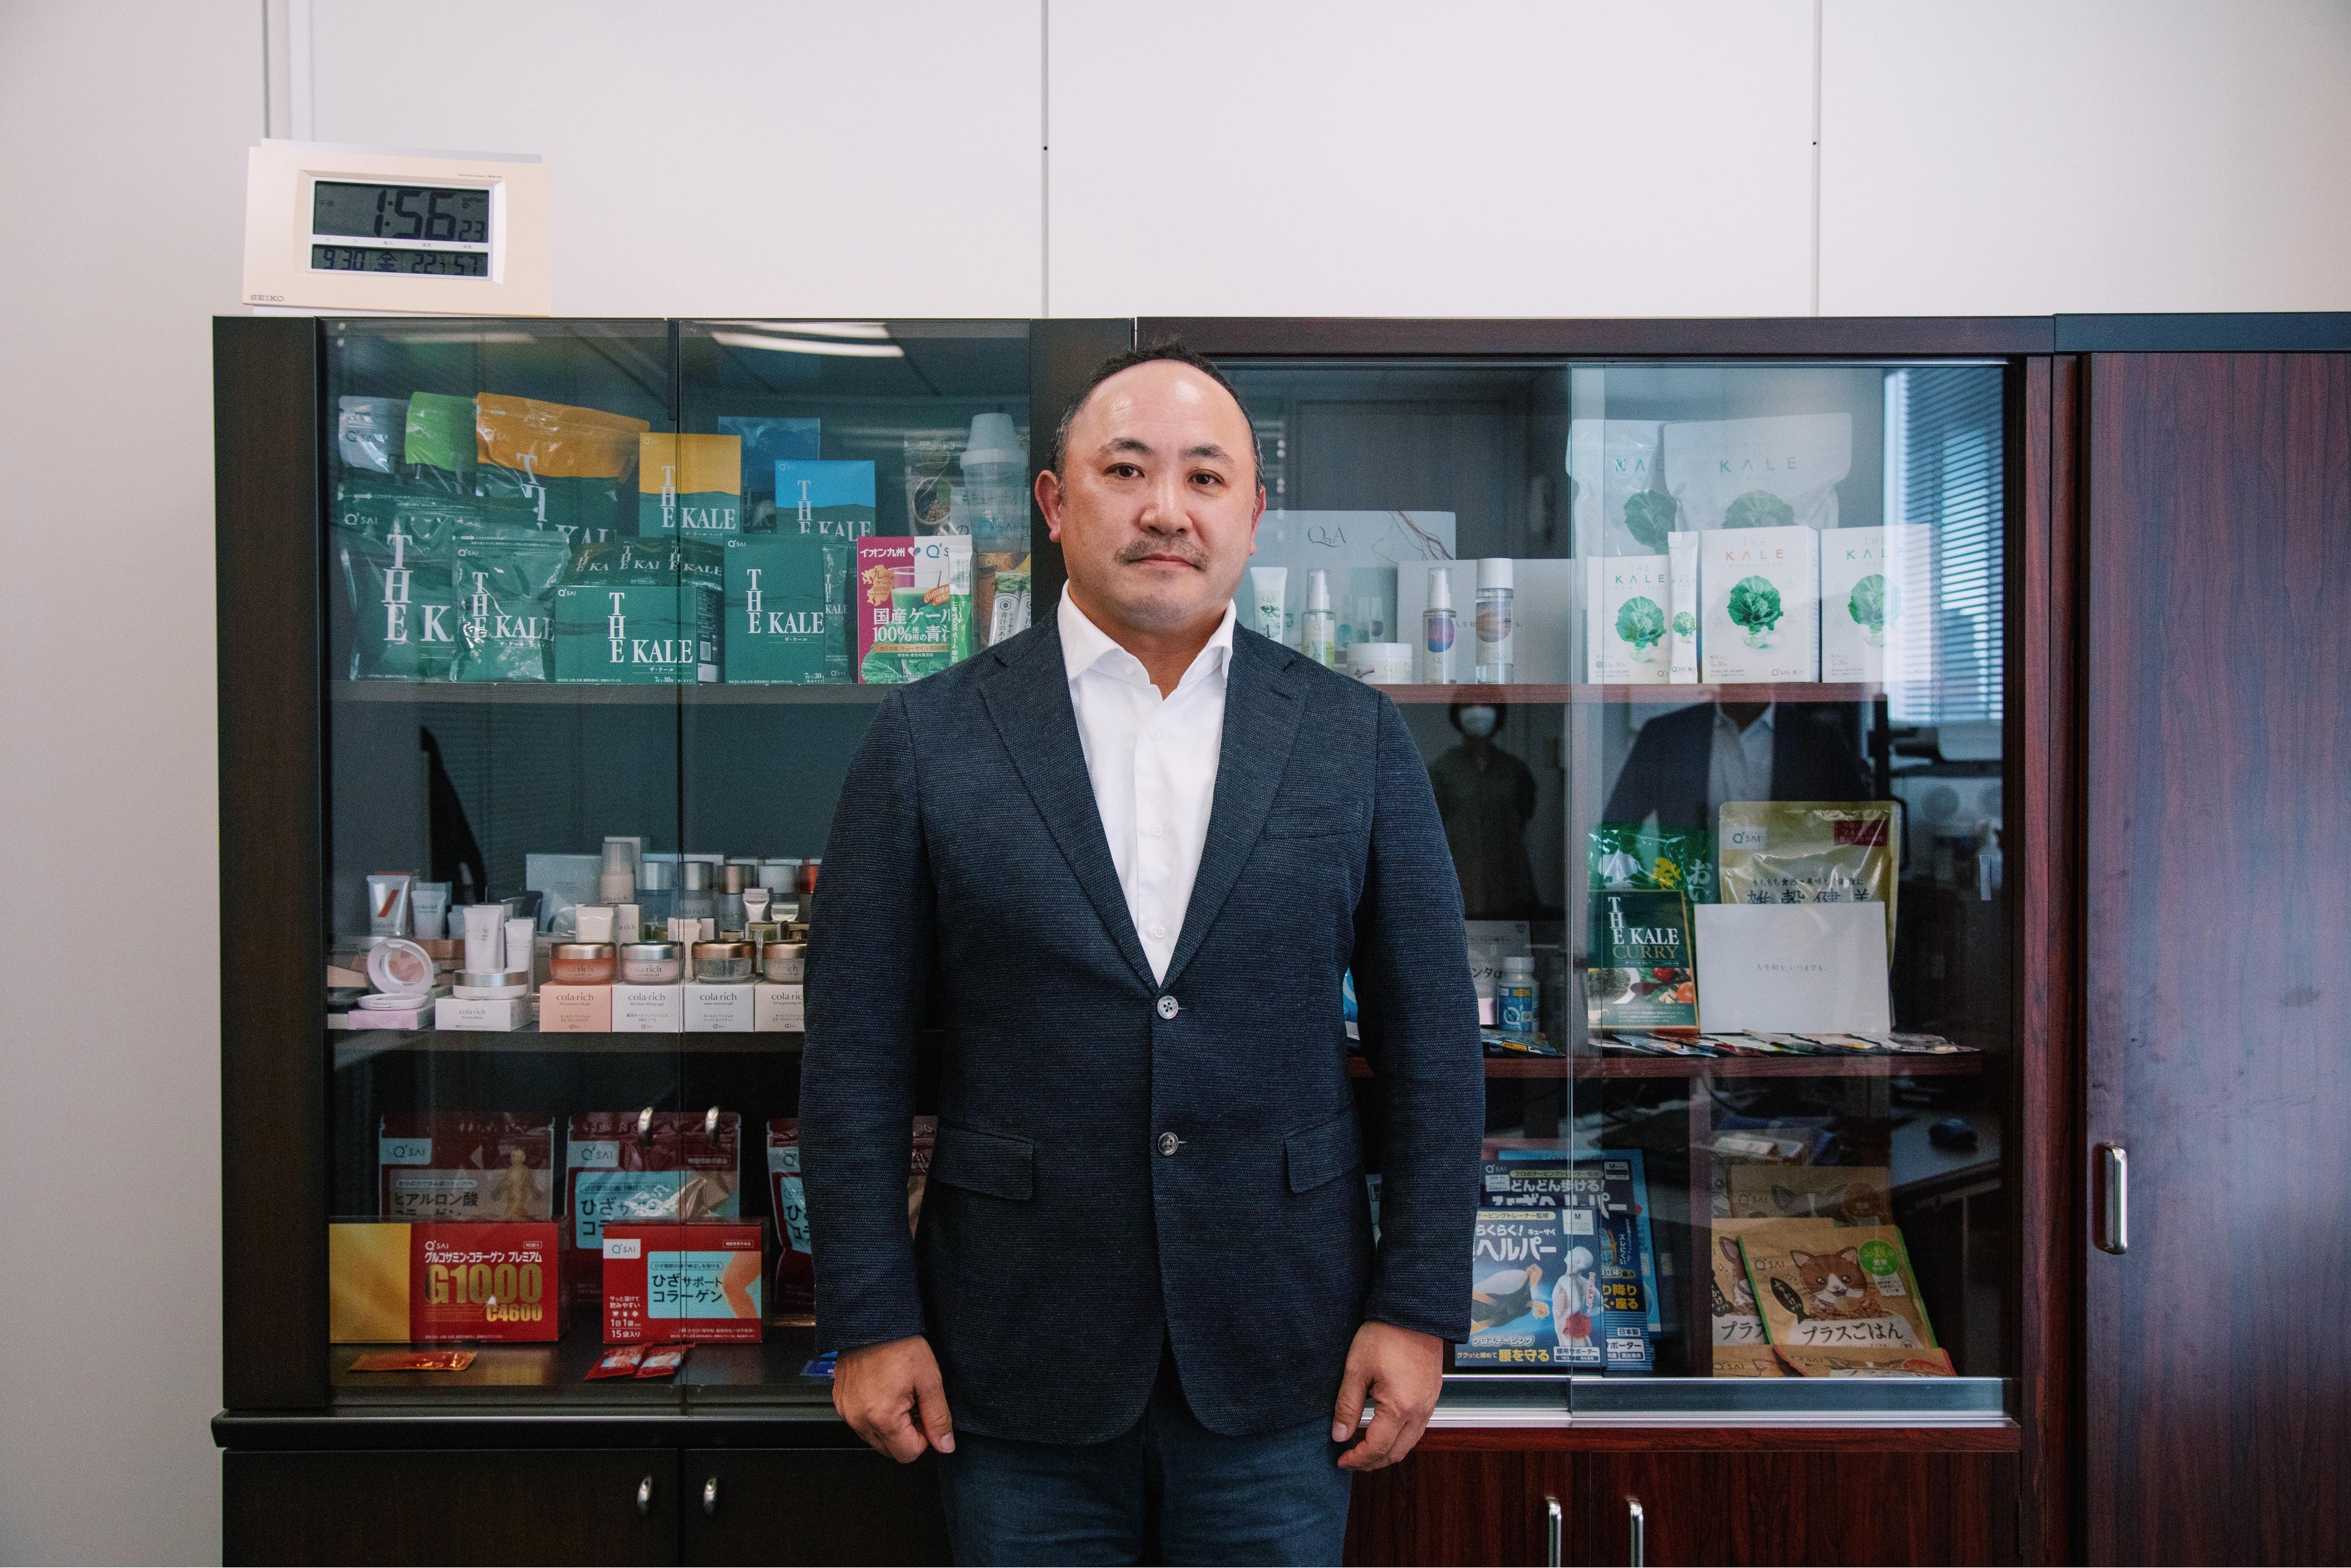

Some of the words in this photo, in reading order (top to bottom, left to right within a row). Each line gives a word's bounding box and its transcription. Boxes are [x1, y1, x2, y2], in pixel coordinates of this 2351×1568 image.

[374, 189, 456, 241] 1:56
[458, 220, 485, 242] 23
[323, 247, 336, 269] 9
[340, 249, 365, 271] 30
[373, 252, 398, 272] 金
[1719, 457, 1797, 473] KALE
[660, 465, 676, 527] THE
[681, 508, 735, 529] KALE
[344, 512, 377, 525] Q'SAI
[819, 521, 872, 541] KALE
[458, 548, 478, 556] Q'SAI
[860, 547, 905, 558] イオン九州
[1726, 549, 1784, 561] KALE
[684, 563, 723, 576] KALE
[1615, 575, 1664, 584] KALE
[381, 534, 414, 641] THE
[746, 569, 763, 634] THE
[768, 612, 825, 634] KALE
[494, 616, 555, 641] KALE
[608, 593, 626, 663] THE
[632, 640, 693, 663] KALE
[1733, 832, 1761, 844] Q'SAI
[1608, 897, 1624, 944] THE
[1631, 928, 1679, 945] KALE
[1613, 945, 1678, 959] CURRY
[772, 991, 804, 1000] cola·ric
[393, 1145, 426, 1158] Q'SAI
[1485, 1164, 1507, 1173] Q'SAI
[395, 1192, 478, 1206] ヒアルロン酸
[426, 1240, 449, 1250] Q'SAI
[612, 1244, 635, 1254] Q'SAI
[1473, 1237, 1556, 1261] ヘルパー
[425, 1252, 505, 1263] グルコサミン・コラーゲン
[508, 1252, 542, 1263] プレミアム
[425, 1264, 542, 1304] G1000
[653, 1289, 722, 1303] コラーゲン
[486, 1304, 543, 1321] C4600
[1802, 1323, 1903, 1344] プラスごはん
[1473, 1337, 1534, 1345] クロステーピング
[1499, 1349, 1549, 1362] 腰を守る
